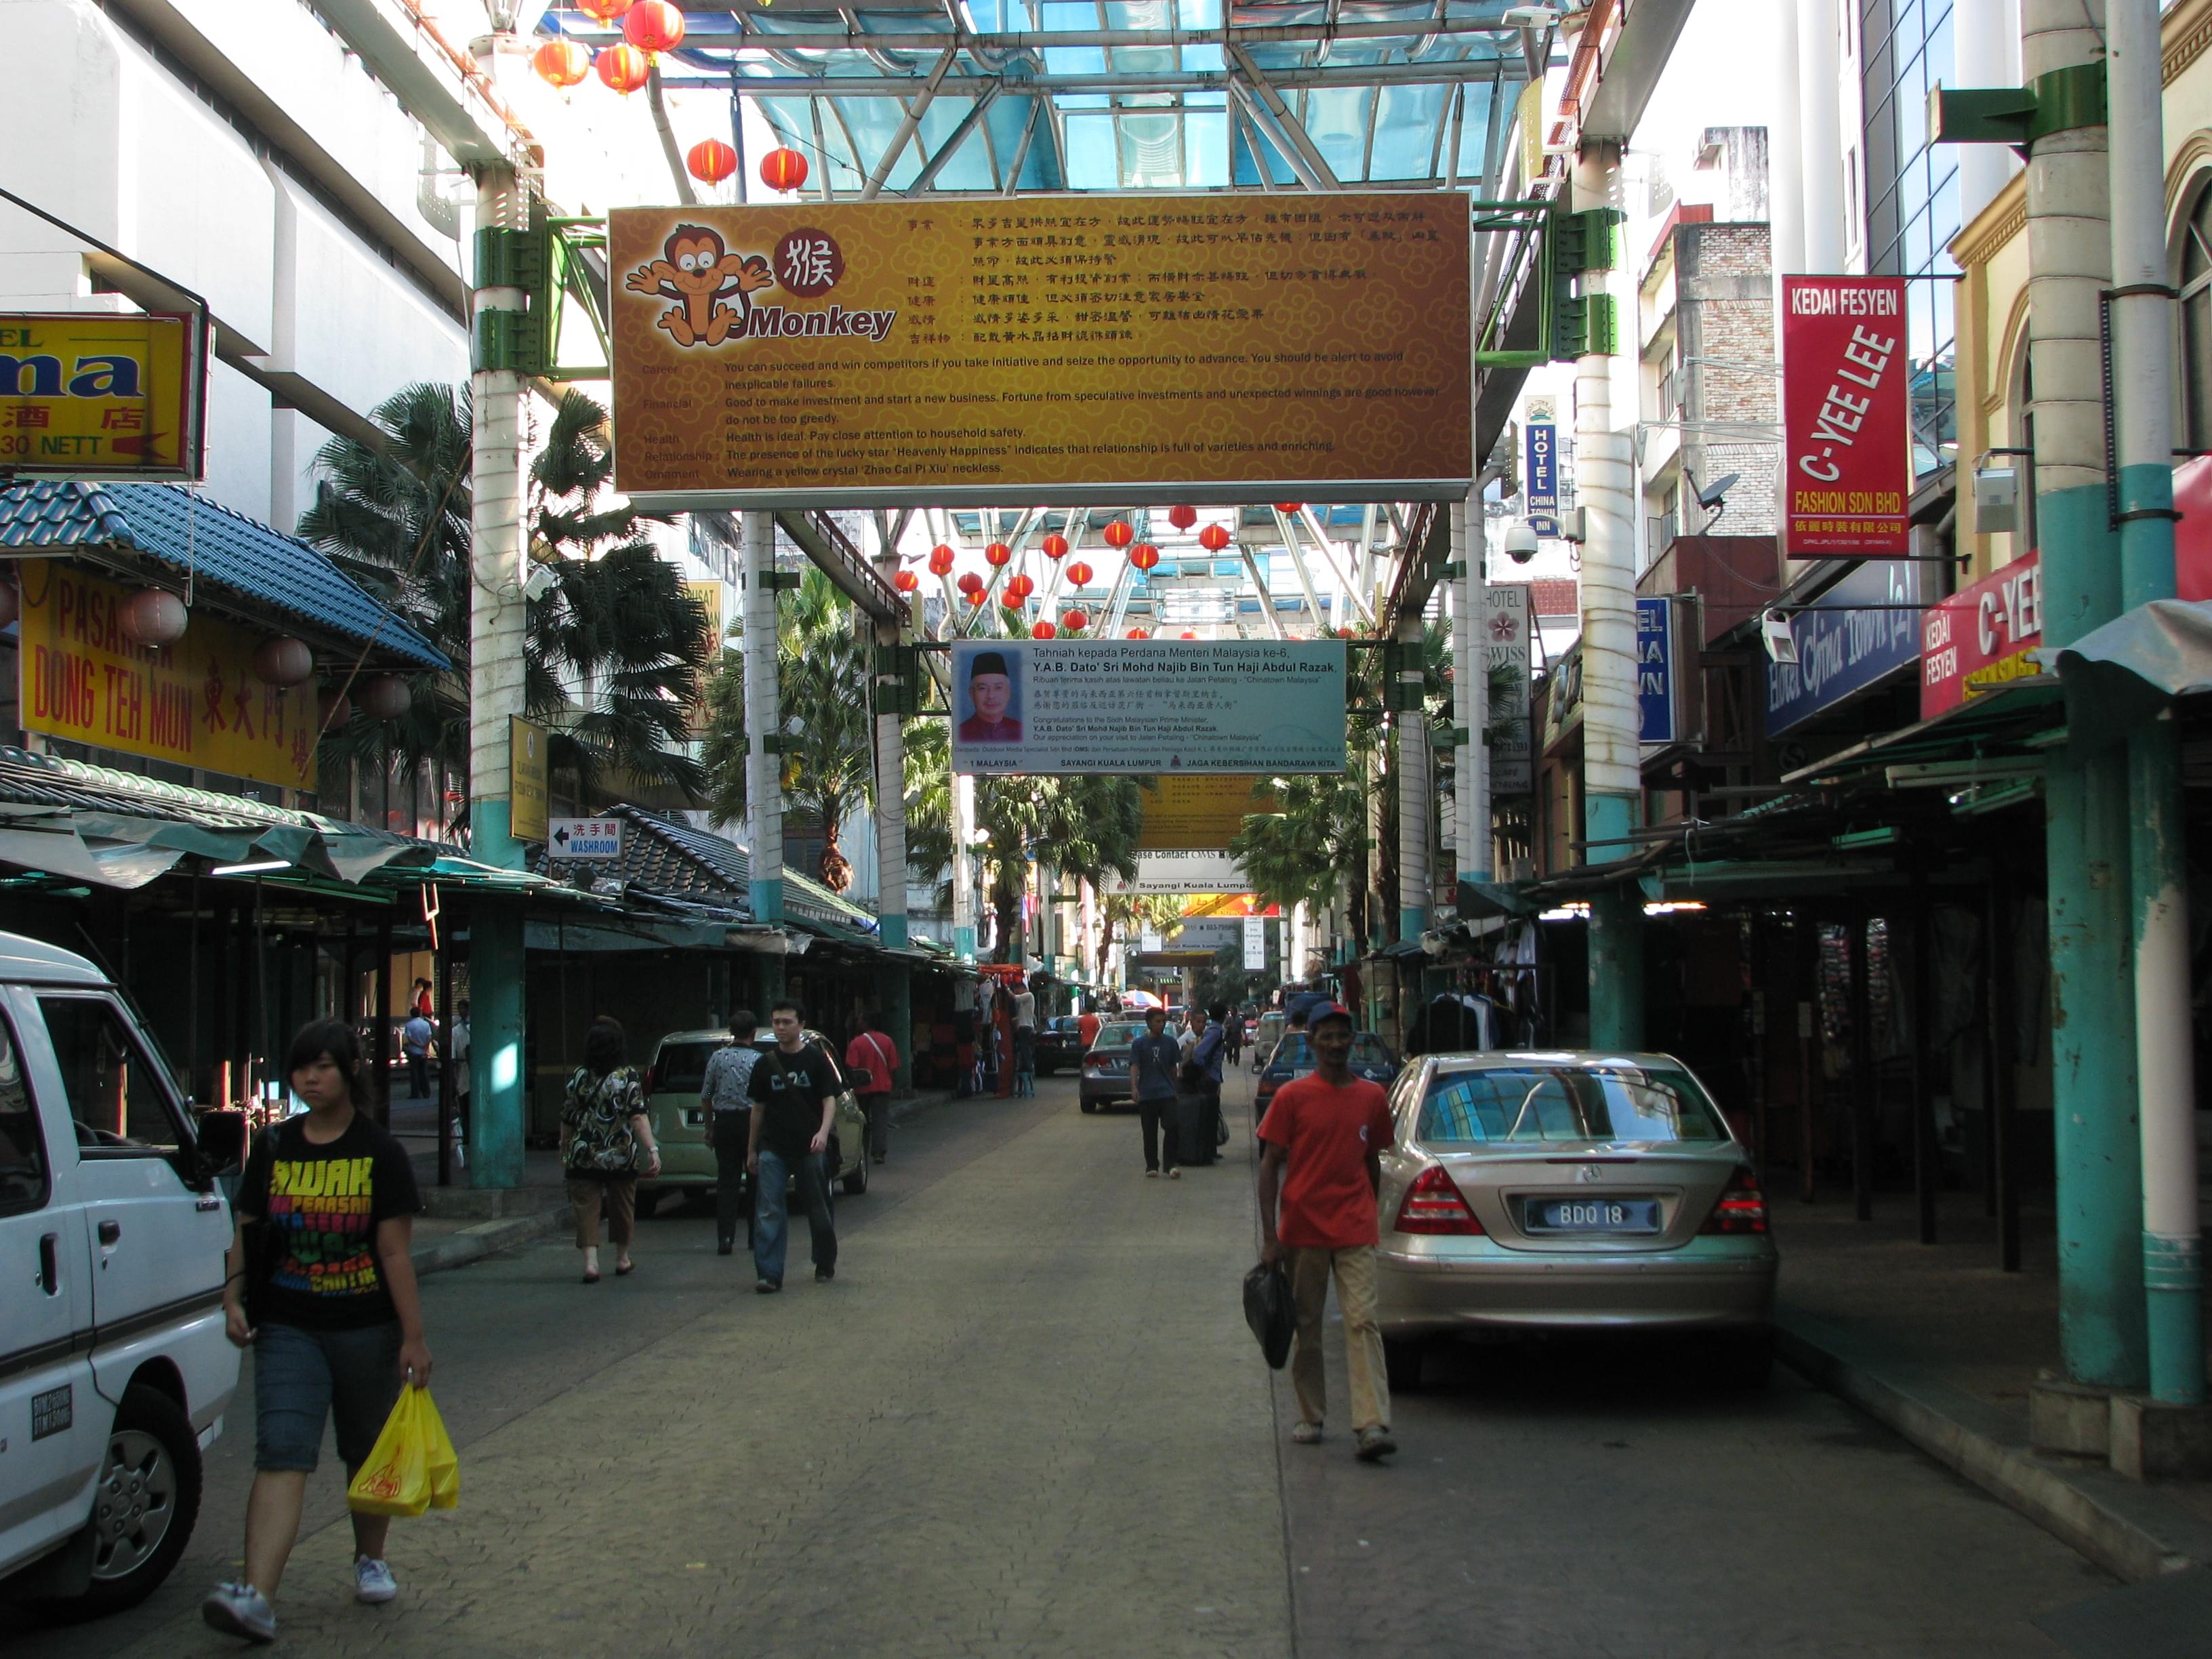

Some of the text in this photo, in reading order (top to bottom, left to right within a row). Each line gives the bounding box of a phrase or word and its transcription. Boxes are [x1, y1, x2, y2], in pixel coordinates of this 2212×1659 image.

[785, 238, 835, 287] 猴
[1791, 287, 1898, 316] KEDAI FESYEN
[747, 305, 897, 342] Monkey
[724, 351, 1404, 373] You can succeed and win competitors if you take initiative and seize the opportunity to advance. You should be alert to avoid
[725, 378, 837, 392] inexplicable failures.
[724, 397, 753, 407] Good
[756, 398, 766, 407] to
[769, 396, 800, 407] make
[802, 396, 861, 405] investment
[864, 395, 884, 405] and
[887, 394, 912, 404] start
[949, 393, 1000, 403] business.
[1002, 392, 1043, 402] Fortune
[1046, 391, 1071, 401] from
[1074, 391, 1134, 403] speculative
[1138, 390, 1203, 399] investments
[1206, 389, 1227, 399] and
[1229, 388, 1291, 400] unexpected
[1294, 387, 1342, 401] winnings
[1344, 388, 1362, 398] are
[1364, 387, 1392, 399] good
[1394, 387, 1440, 397] however
[1798, 384, 1871, 483] C-YEE
[1837, 324, 1896, 390] LEE
[726, 428, 1026, 442] Health is ideal. Pay close attention to household safety.
[41, 436, 104, 455] NETT
[726, 449, 746, 460] The
[750, 451, 799, 461] presence
[802, 449, 813, 459] of
[816, 448, 834, 458] the
[836, 448, 865, 459] lucky
[867, 448, 889, 457] star
[1015, 445, 1064, 455] indicates
[1067, 444, 1089, 454] that
[1092, 443, 1158, 455] relationship
[1161, 443, 1170, 453] is
[1173, 443, 1190, 452] full
[1193, 442, 1204, 452] of
[1208, 442, 1254, 452] varieties
[1257, 441, 1278, 451] and
[1281, 441, 1334, 453] enriching.
[1534, 429, 1549, 490] HOTEL
[1530, 495, 1555, 506] CHINA
[1795, 490, 1901, 514] FASHION SDN BHD
[1536, 520, 1551, 531] INN
[1925, 615, 1951, 652] KEDAI
[1033, 647, 1075, 658] Tahniah
[1078, 647, 1117, 659] kepada
[1120, 647, 1166, 658] Perdana
[1169, 647, 1210, 658] Menteri
[1212, 647, 1260, 659] Malaysia
[1488, 646, 1525, 662] WISS
[1803, 609, 1843, 698] China
[1844, 598, 1886, 667] Town
[1033, 662, 1067, 672] Y.A.B.
[1070, 662, 1101, 672] Dato'
[1103, 662, 1120, 672] Sri
[1122, 662, 1155, 672] Mohd
[1158, 662, 1187, 674] Najib
[1190, 662, 1210, 672] Bin
[1212, 662, 1235, 672] Tun
[1237, 662, 1260, 674] Haji
[1262, 662, 1296, 672] Abdul
[1925, 647, 1957, 686] FESYEN
[35, 644, 193, 754] DONG TEH MUN
[573, 823, 617, 837] 洗手間
[570, 840, 618, 854] WASHROOM
[1155, 850, 1189, 859] Contact
[1139, 882, 1181, 890] Sayangi
[1603, 1204, 1622, 1224] 18
